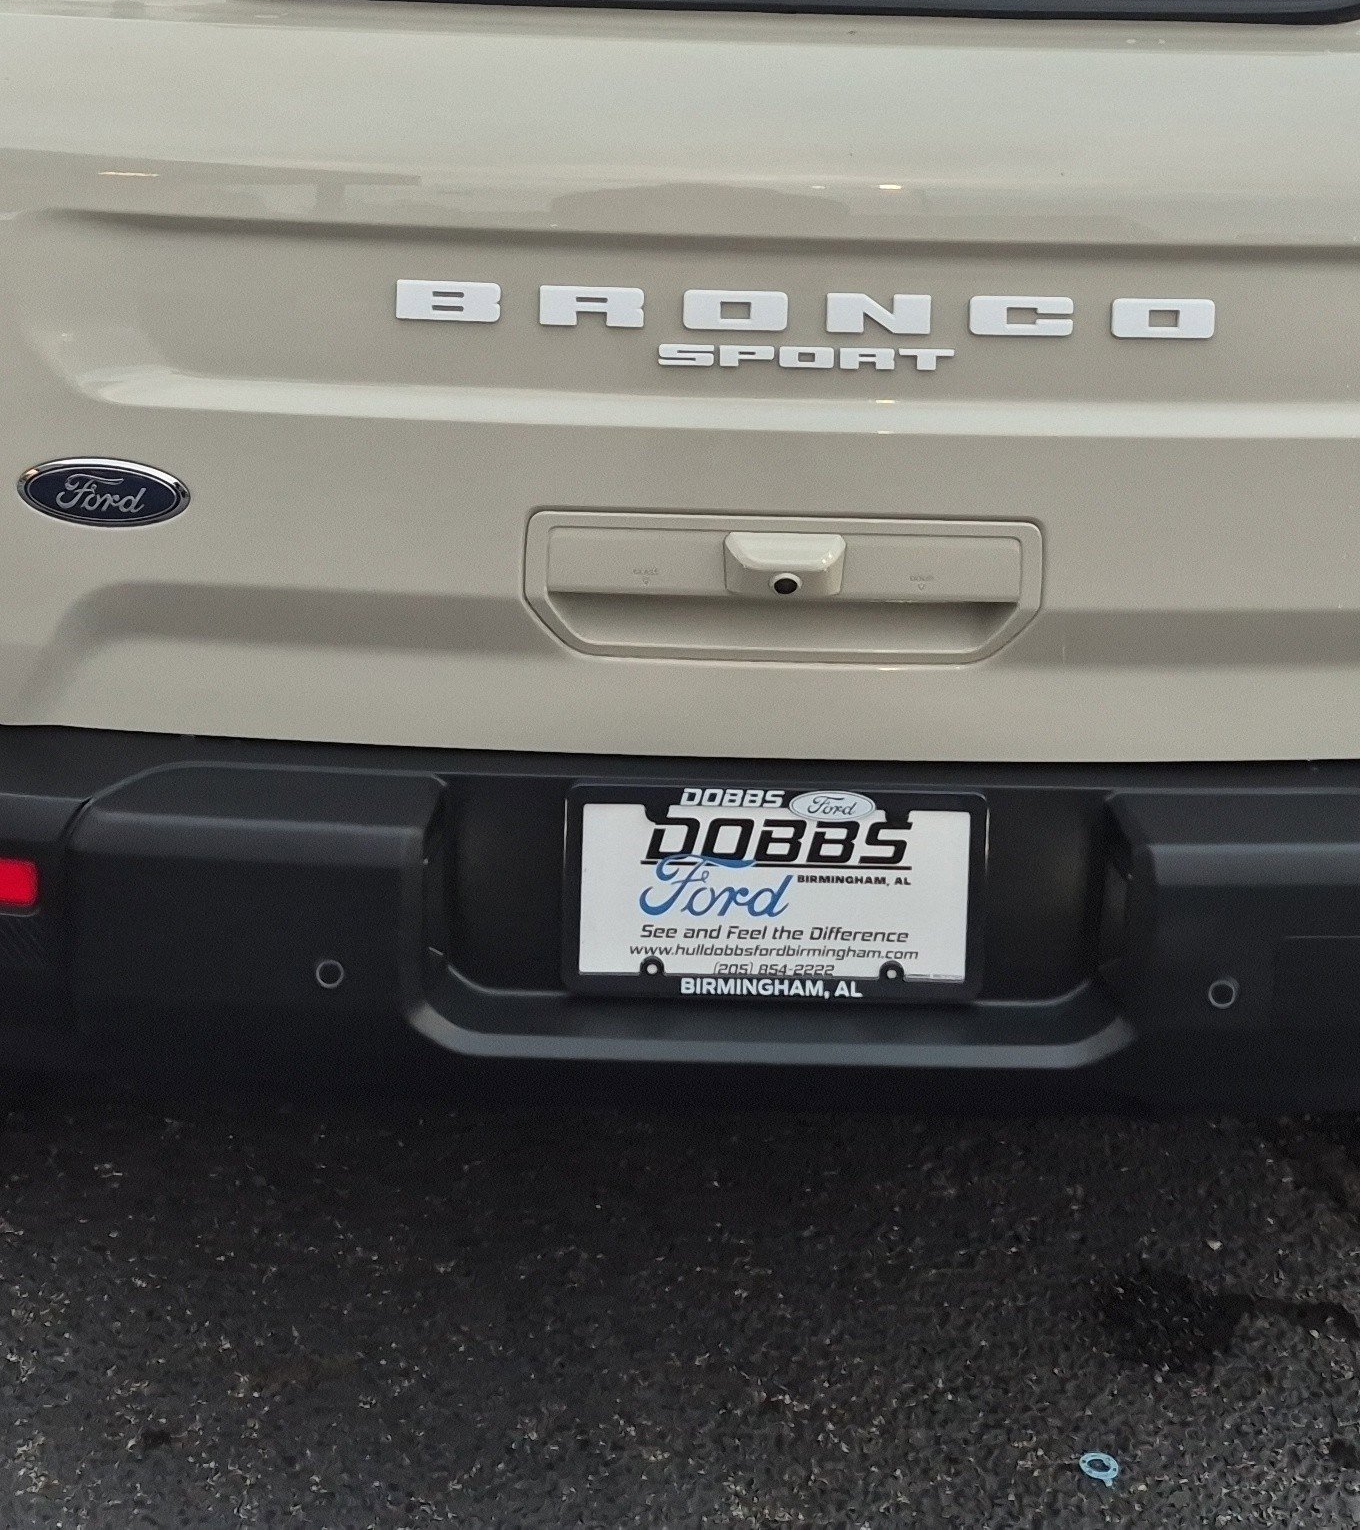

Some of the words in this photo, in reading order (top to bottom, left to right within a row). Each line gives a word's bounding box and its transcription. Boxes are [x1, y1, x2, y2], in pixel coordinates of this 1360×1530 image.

[395, 278, 1216, 339] BRONCO
[657, 343, 955, 370] SPORT
[55, 473, 147, 513] Ford
[680, 787, 785, 808] DOBBS
[807, 795, 858, 816] Ford
[646, 817, 913, 865] DOBBS
[639, 854, 794, 918] Ford
[797, 874, 890, 886] BIRMINGHAM,
[894, 876, 912, 886] AL
[640, 924, 677, 938] See
[683, 925, 722, 939] and
[727, 925, 767, 940] Feel
[772, 926, 804, 940] the
[810, 927, 909, 943] Difference
[629, 943, 919, 961] www.hulldobbsfordbirmingham.com
[713, 961, 754, 975] (205)
[759, 963, 835, 976] 854-2222
[680, 977, 830, 999] BIRMINGHAM,
[834, 980, 864, 998] AL
